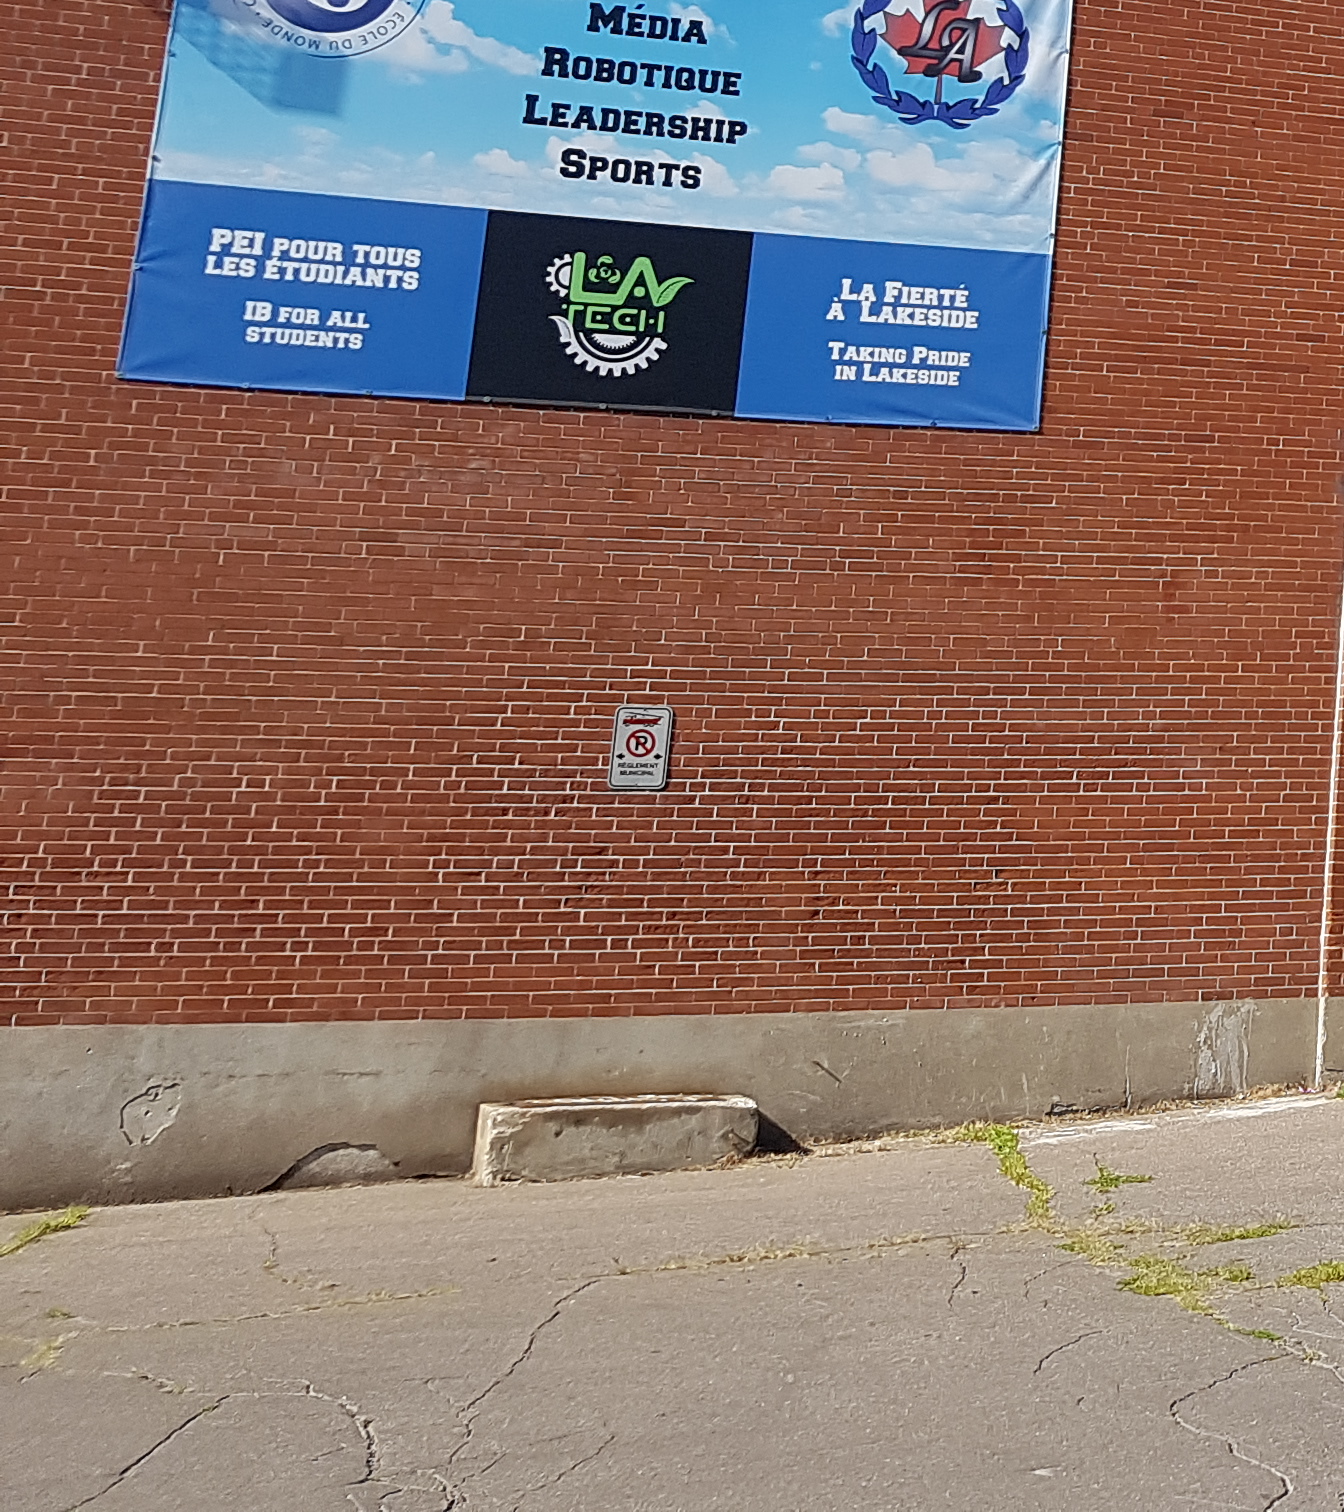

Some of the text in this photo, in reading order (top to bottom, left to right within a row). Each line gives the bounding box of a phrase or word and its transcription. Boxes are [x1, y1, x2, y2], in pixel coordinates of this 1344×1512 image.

[261, 17, 321, 51] MONDE
[586, 3, 708, 46] MÉDIA
[329, 37, 353, 51] DU
[541, 47, 743, 97] ROBOTIQUE
[522, 94, 749, 144] LEADERSHIP
[559, 148, 703, 189] SPORTS
[208, 228, 421, 268] PEI POUR TOUS
[204, 255, 420, 291] LES ÉTUDIANTS
[840, 278, 970, 308] LA FIERTÉ
[243, 300, 370, 329] IB FOR ALL
[561, 303, 665, 334] TECH
[826, 296, 980, 330] À LAKESIDE
[244, 326, 364, 350] STUDENTS
[828, 341, 971, 368] TAKING PRIDE
[834, 363, 961, 387] IN LAKESIDE
